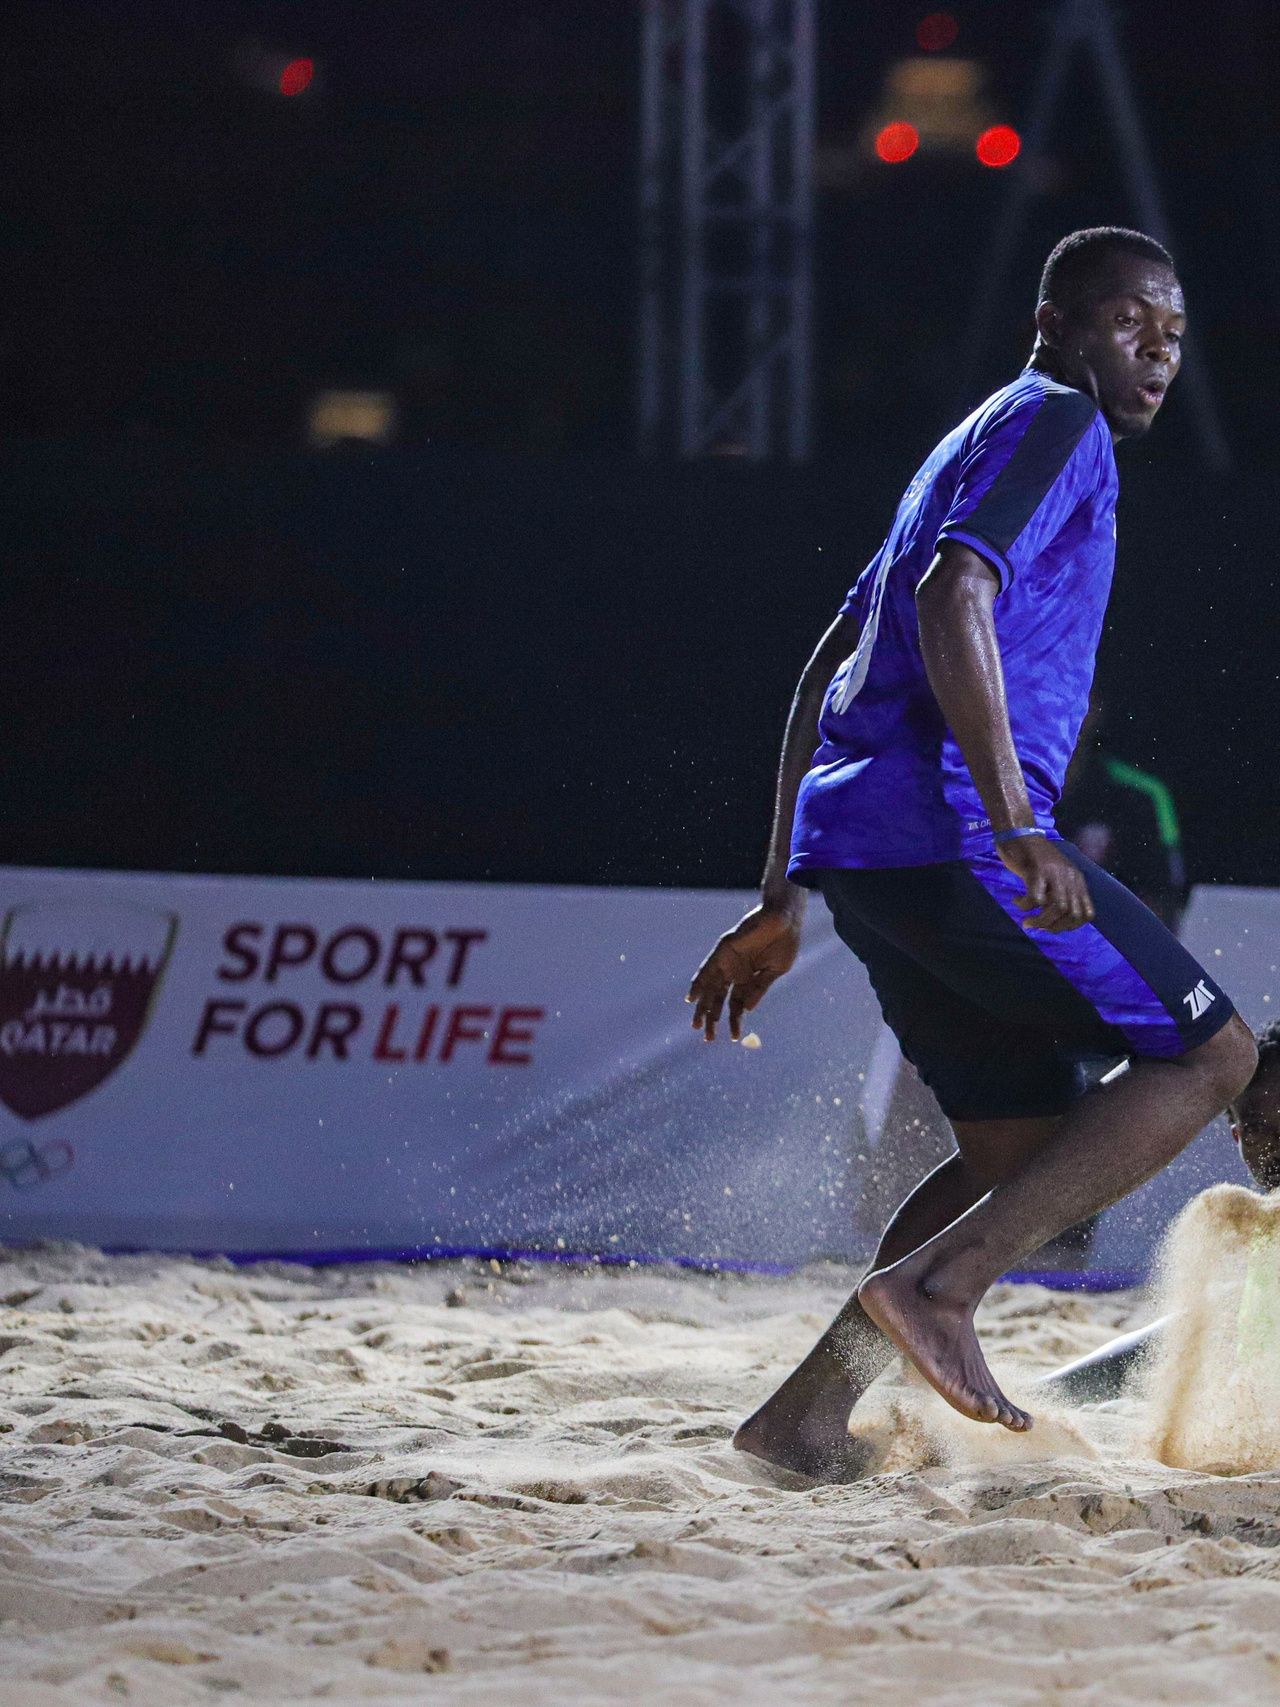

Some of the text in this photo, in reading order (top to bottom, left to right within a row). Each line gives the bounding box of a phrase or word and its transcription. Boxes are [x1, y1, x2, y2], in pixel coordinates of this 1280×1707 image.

[216, 921, 488, 989] SPORT
[0, 1019, 118, 1057] QATAR
[191, 998, 547, 1067] FOR LIFE
